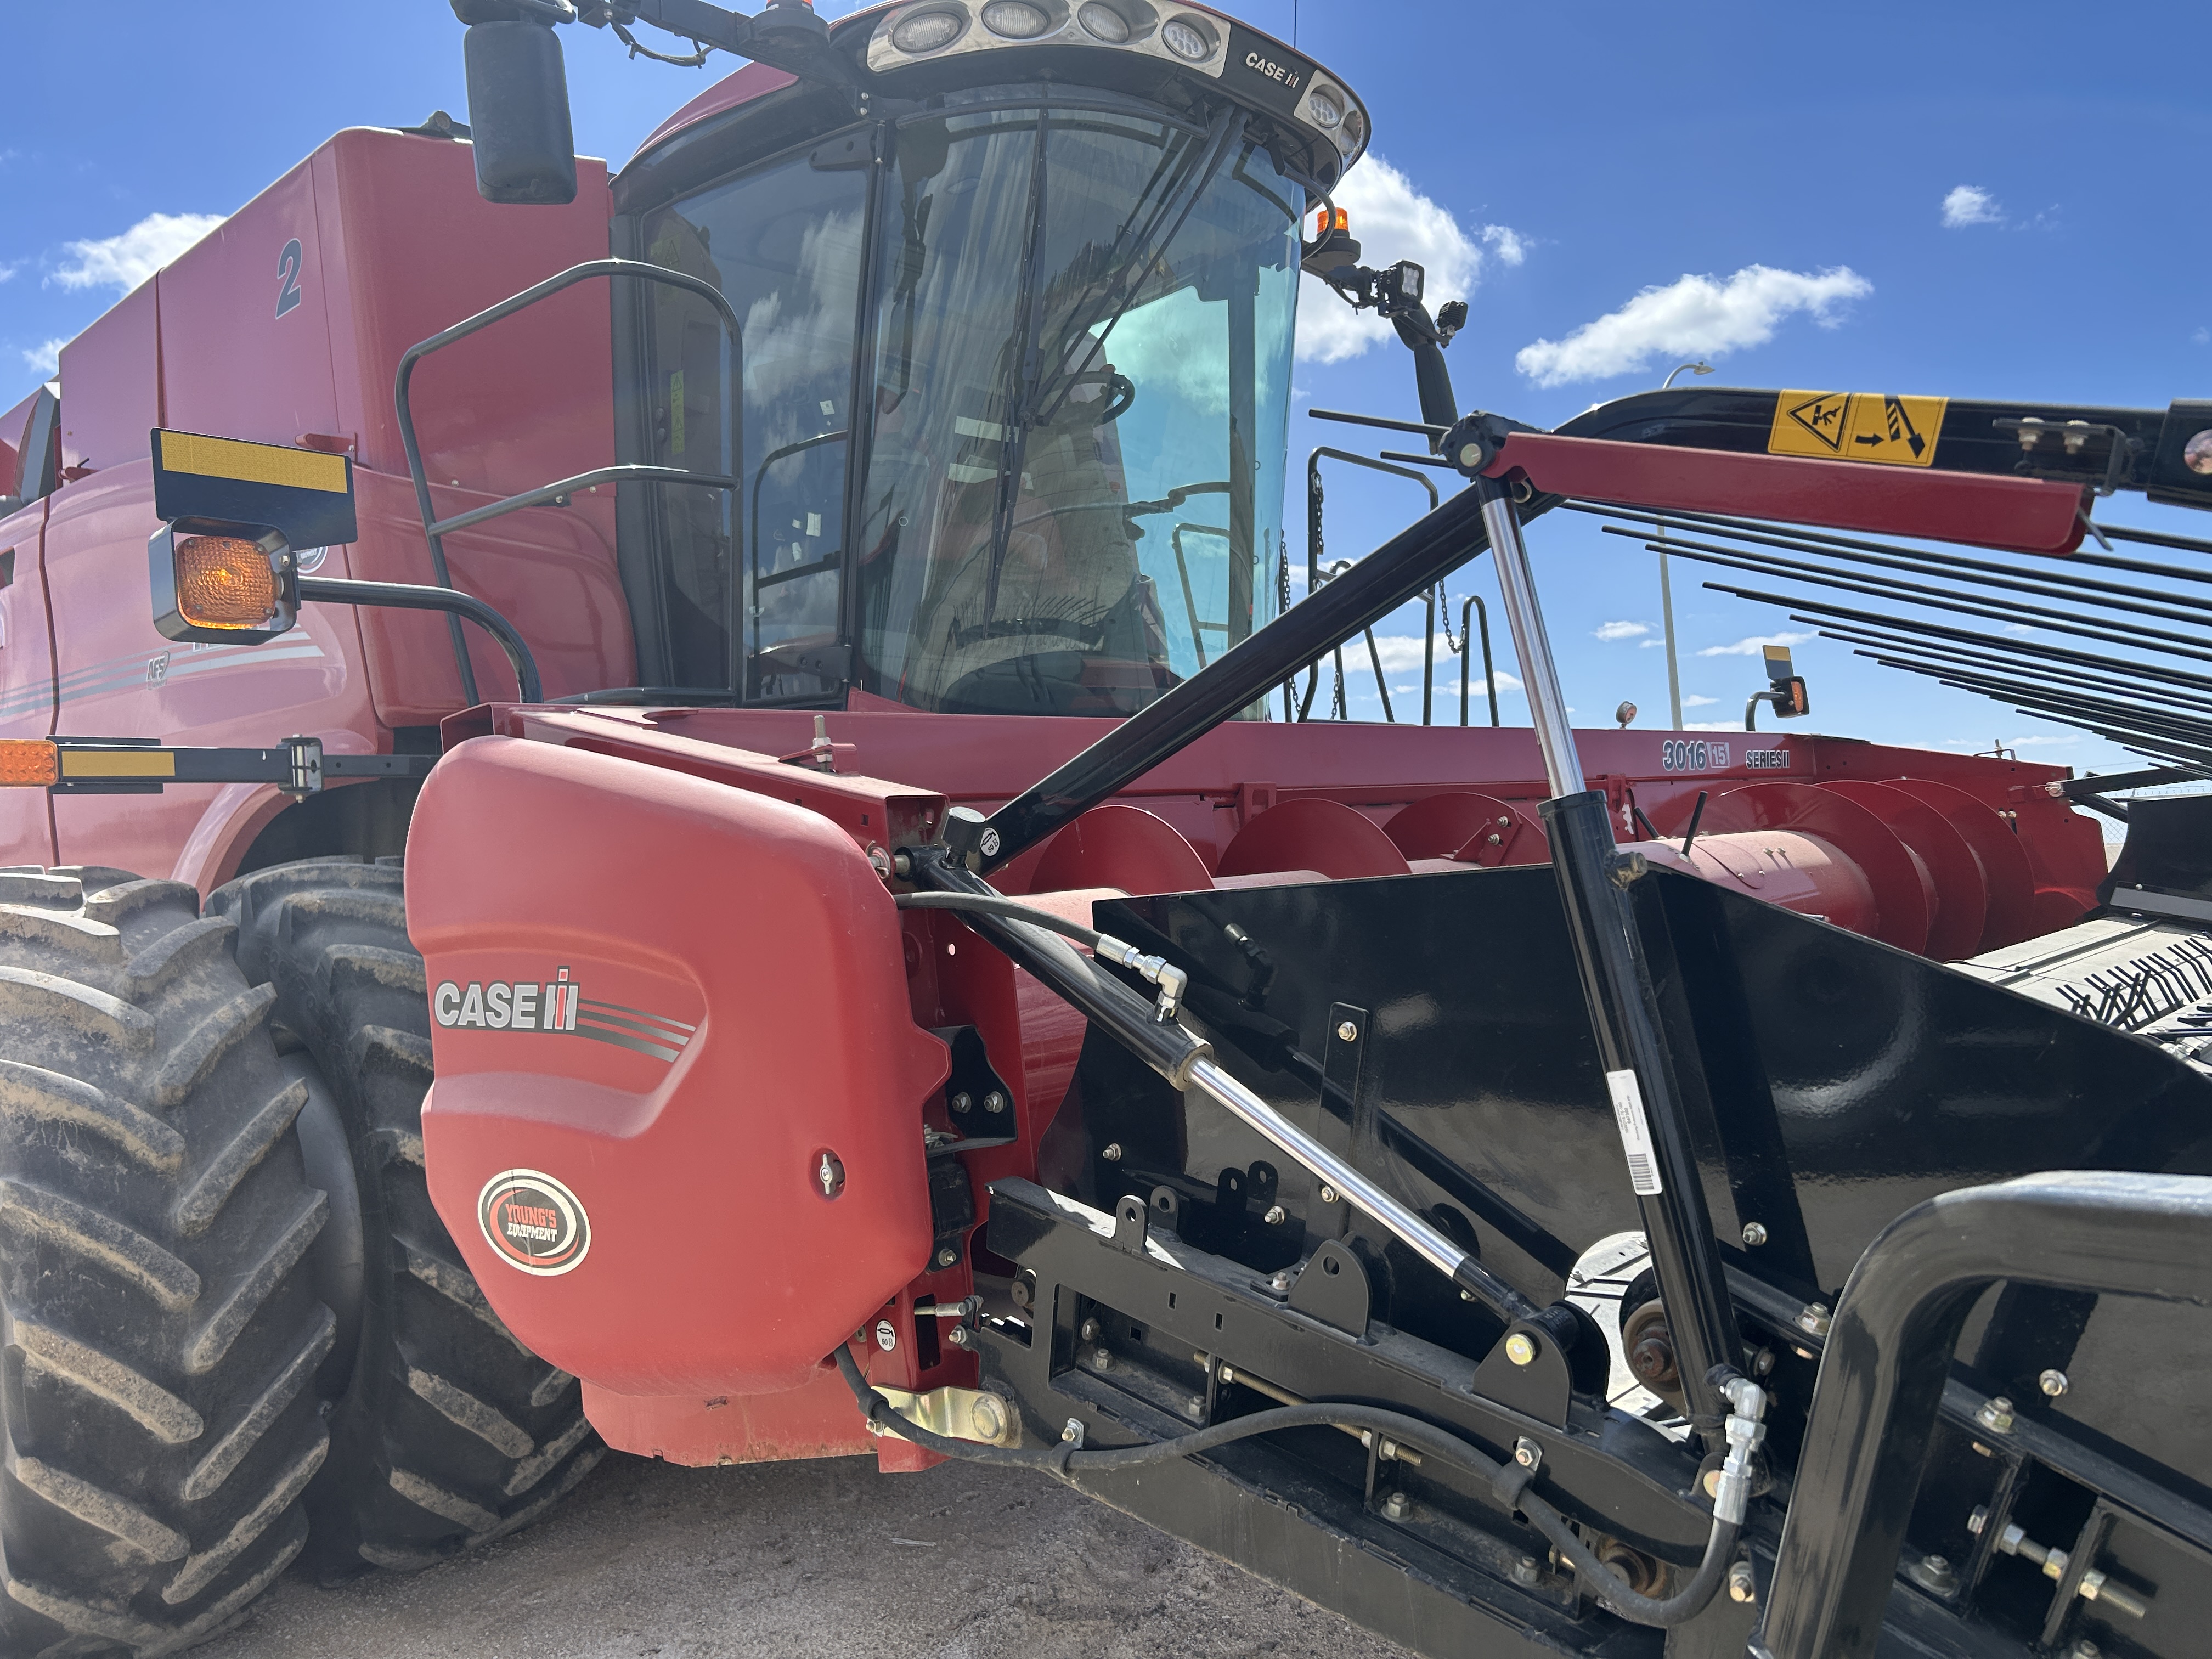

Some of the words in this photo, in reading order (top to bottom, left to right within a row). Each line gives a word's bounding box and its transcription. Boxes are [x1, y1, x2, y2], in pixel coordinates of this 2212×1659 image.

[1246, 52, 1286, 81] CASE
[275, 238, 302, 320] 2
[1663, 740, 1706, 771] 3016
[1712, 746, 1726, 765] 15
[1746, 749, 1782, 770] SERIES
[435, 983, 539, 1029] CASE
[505, 1203, 557, 1229] YOUNG'S
[507, 1222, 558, 1242] EQUIPMENT
